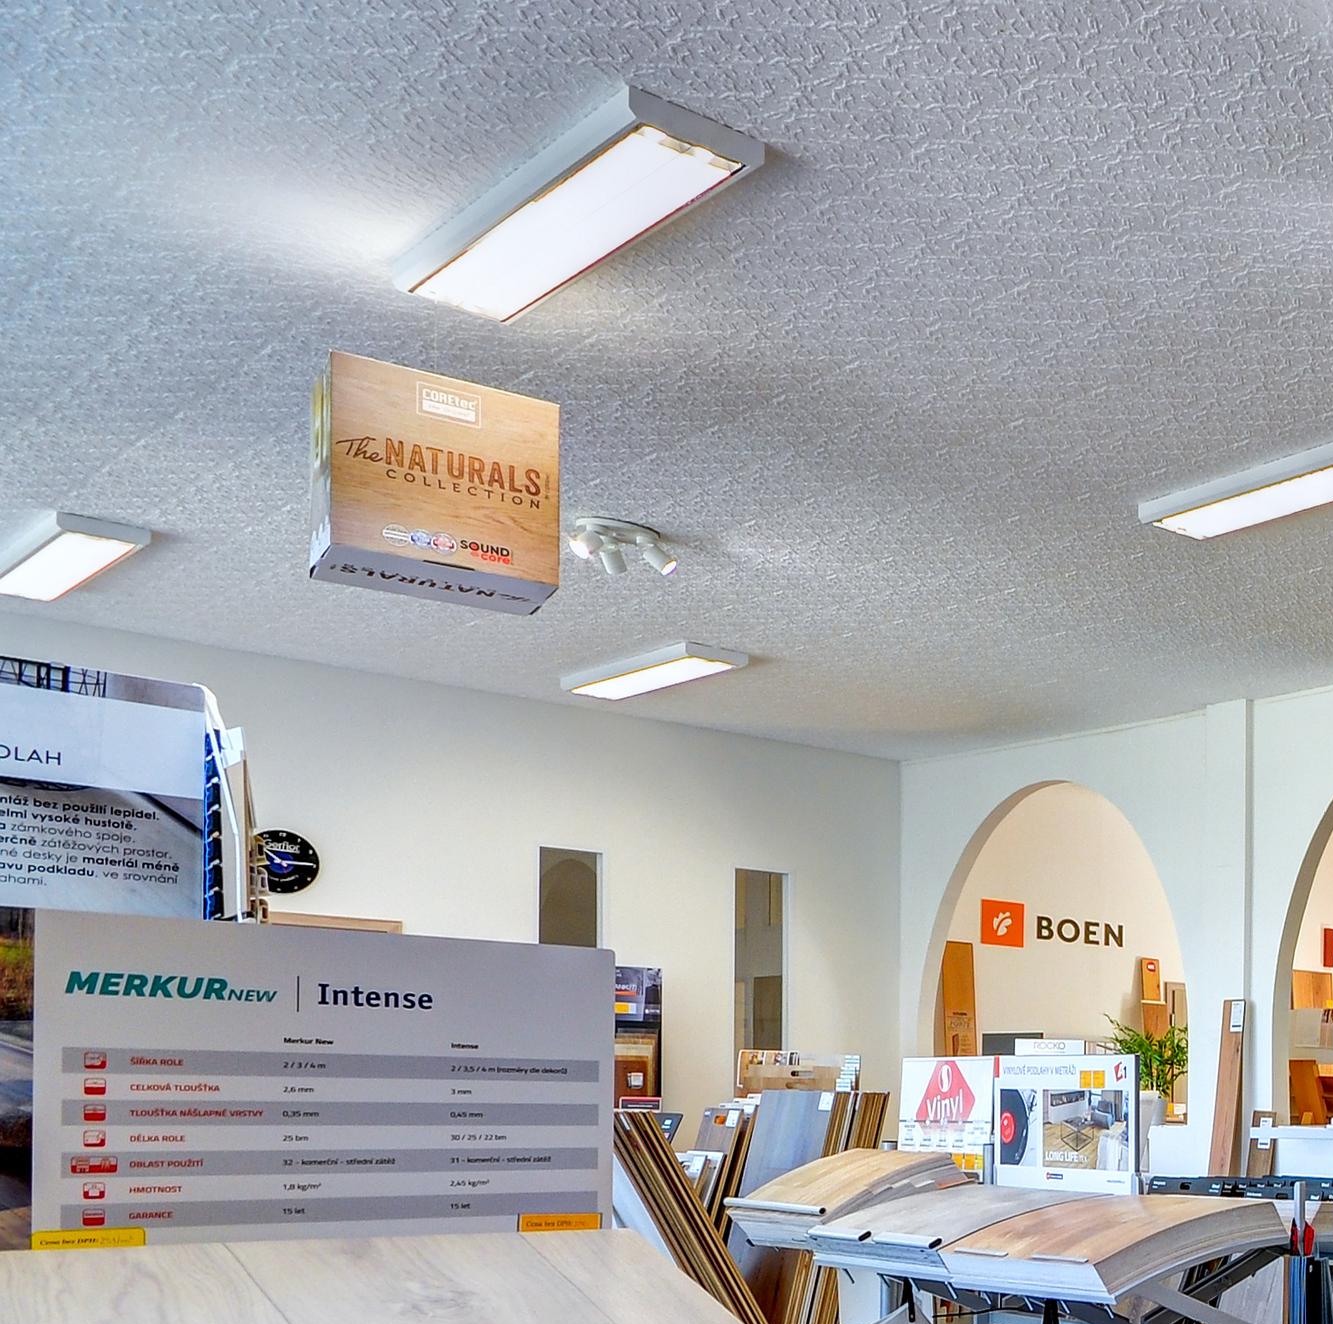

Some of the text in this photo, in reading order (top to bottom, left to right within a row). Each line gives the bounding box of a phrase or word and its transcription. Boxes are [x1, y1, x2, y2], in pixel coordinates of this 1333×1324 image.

[336, 436, 541, 497] The NATURALS
[386, 468, 541, 510] COLLECTION
[460, 539, 510, 557] SOUND
[480, 553, 512, 565] core
[33, 797, 58, 809] bez
[62, 802, 108, 815] použití
[110, 806, 160, 821] lepidel.
[31, 811, 81, 825] vysoké
[84, 816, 138, 831] hustotě.
[10, 821, 136, 843] zámkového spoje.
[123, 847, 173, 860] prostor.
[23, 850, 180, 872] desky je materiál méně
[102, 871, 119, 880] ve
[123, 872, 179, 885] srovnání
[1036, 915, 1124, 948] BOEN
[65, 971, 228, 1000] MERKUR
[318, 983, 433, 1010] Intense
[283, 1036, 313, 1045] Merkur
[451, 1042, 479, 1050] Intense
[1033, 1040, 1066, 1051] ROCKO
[129, 1056, 184, 1067] ŠÍŘKA ROLE
[130, 1082, 220, 1092] CELKOVÁ TLOUŠŤKA
[130, 1107, 264, 1118] TLOUŠŤKA NÁŠLAPNÉ VRSTVY
[129, 1133, 186, 1143] DÉLKA ROLE
[1045, 1150, 1064, 1161] LONG
[1064, 1151, 1079, 1162] LIFE
[129, 1157, 204, 1169] OBLAST POUŽITÍ
[129, 1185, 183, 1194] HMOTNOST
[129, 1210, 173, 1220] GARANCE
